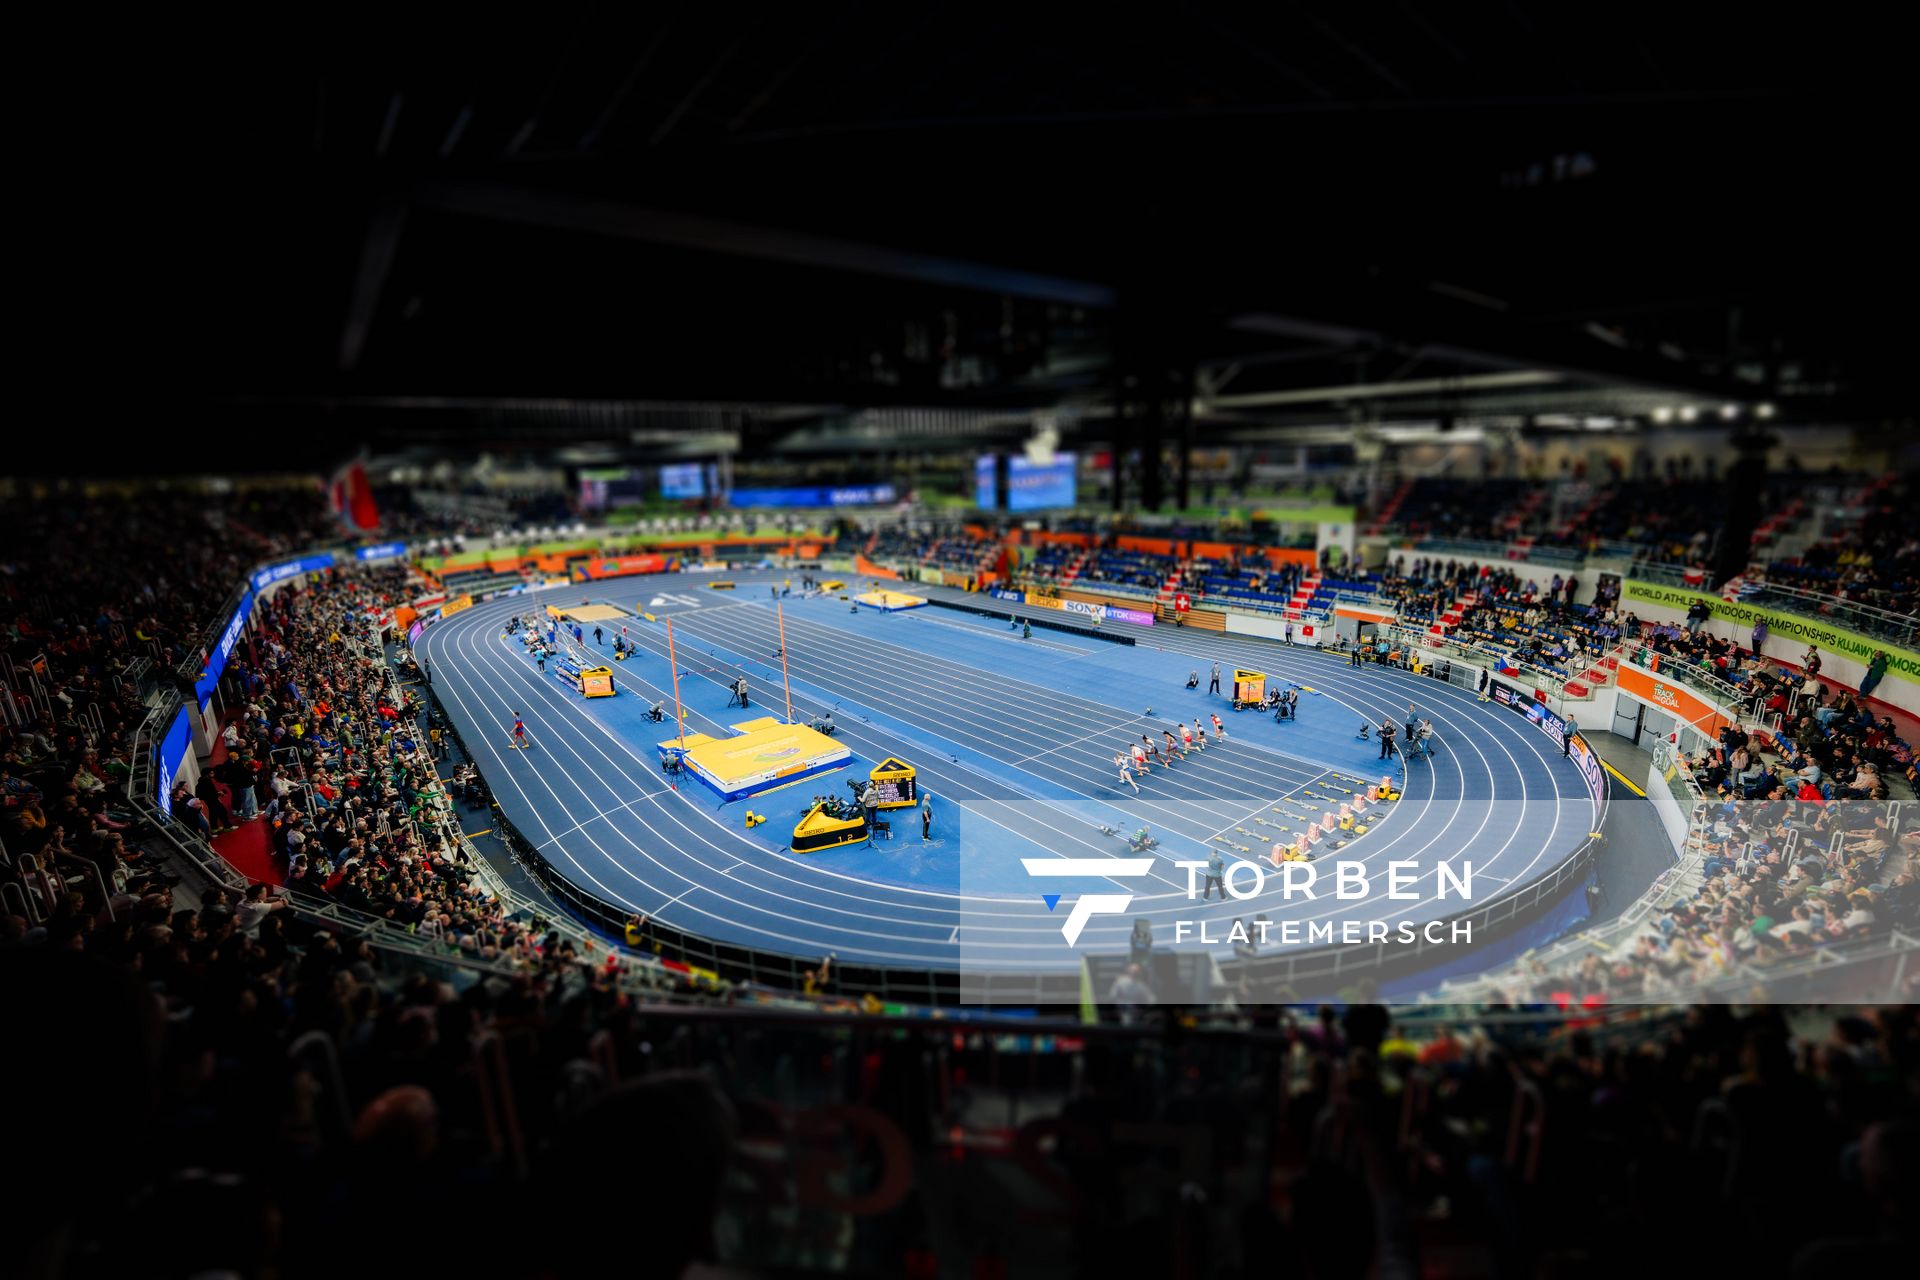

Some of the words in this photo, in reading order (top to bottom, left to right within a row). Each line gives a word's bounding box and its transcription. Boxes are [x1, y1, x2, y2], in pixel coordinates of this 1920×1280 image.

[1030, 594, 1060, 608] SEIKO
[1066, 601, 1102, 615] SONY
[1112, 609, 1129, 620] TDK
[1629, 585, 1662, 600] WORLD
[1715, 603, 1753, 622] INDOOR
[1753, 612, 1837, 646] CHAMPIONSHIPS
[1836, 637, 1877, 660] KUJAWY
[1882, 652, 1920, 677] OMORZ
[1654, 688, 1675, 700] TRACK
[1660, 697, 1680, 708] GOAL
